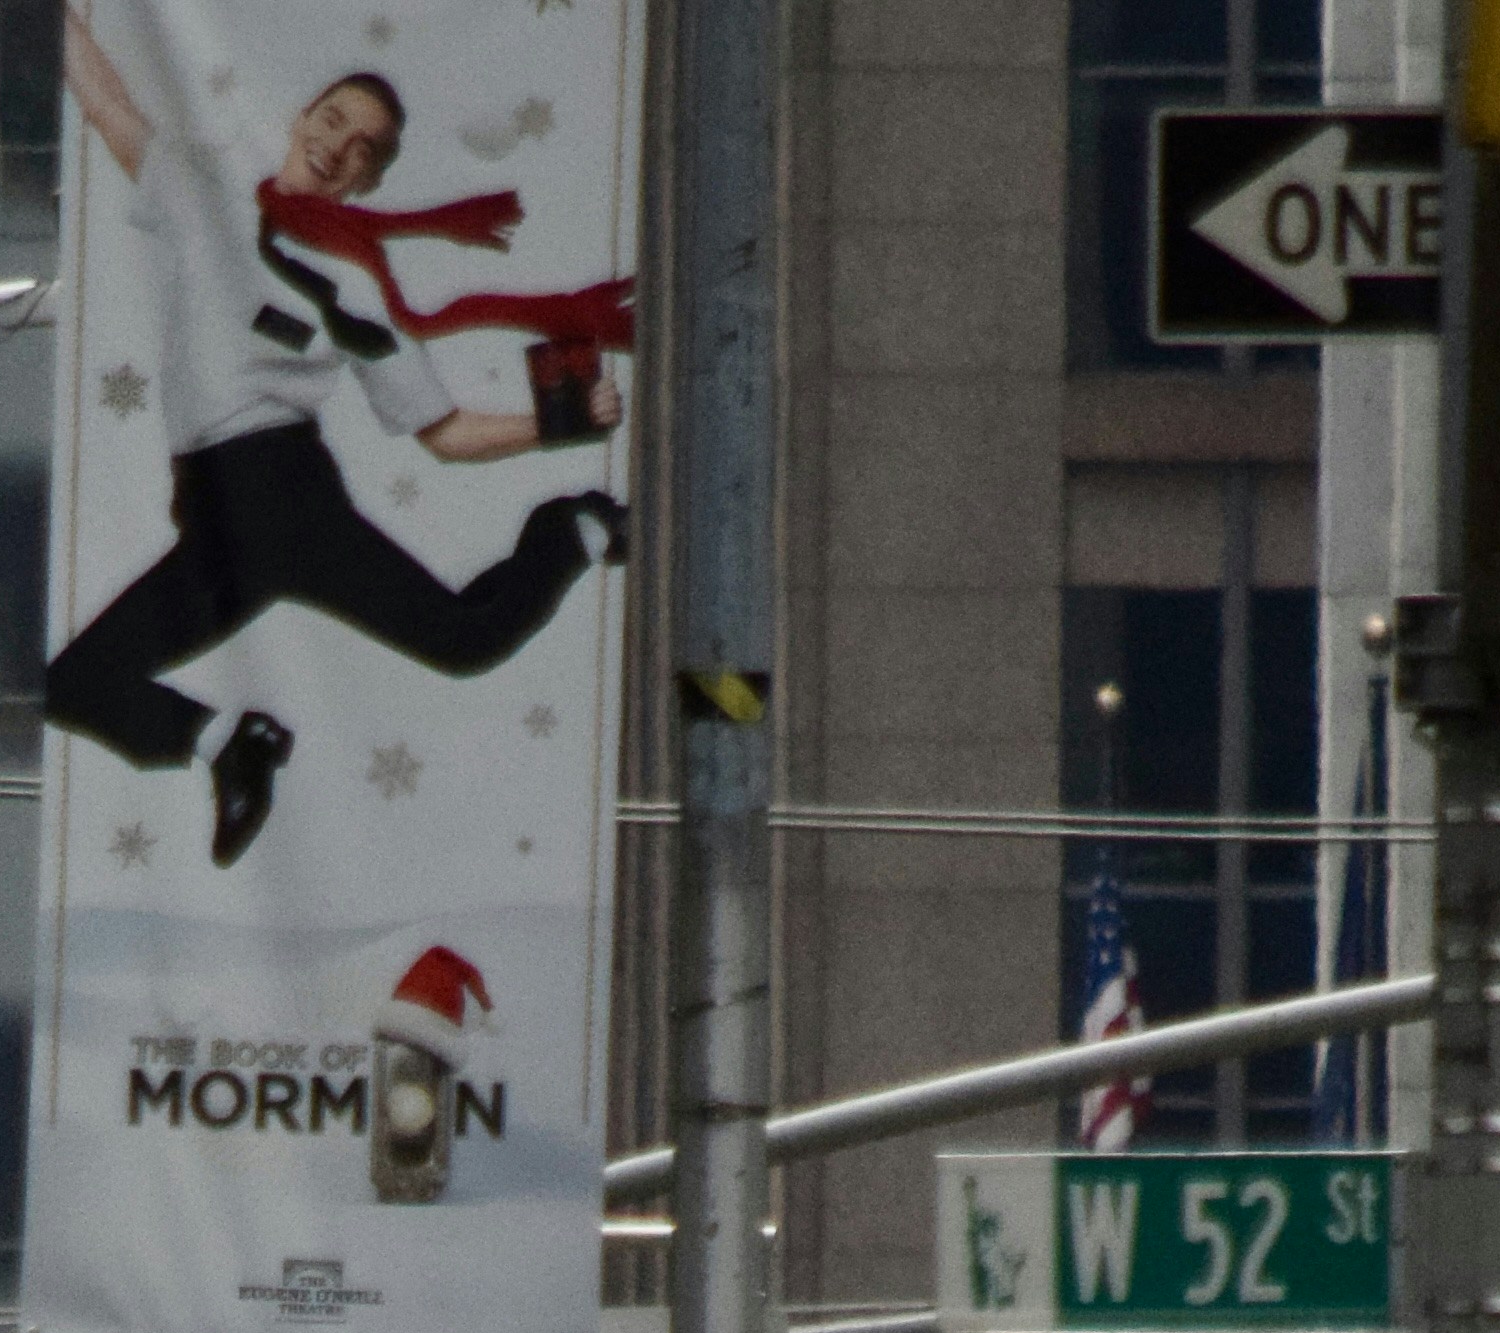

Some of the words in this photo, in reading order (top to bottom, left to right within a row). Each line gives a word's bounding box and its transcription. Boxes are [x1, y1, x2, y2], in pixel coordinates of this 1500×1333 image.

[1264, 183, 1442, 265] ONE
[130, 1036, 196, 1068] THE
[210, 1037, 307, 1070] BOOK
[319, 1041, 368, 1072] OF
[1070, 1185, 1137, 1301] W
[1180, 1181, 1289, 1304] 52
[1325, 1171, 1378, 1243] St
